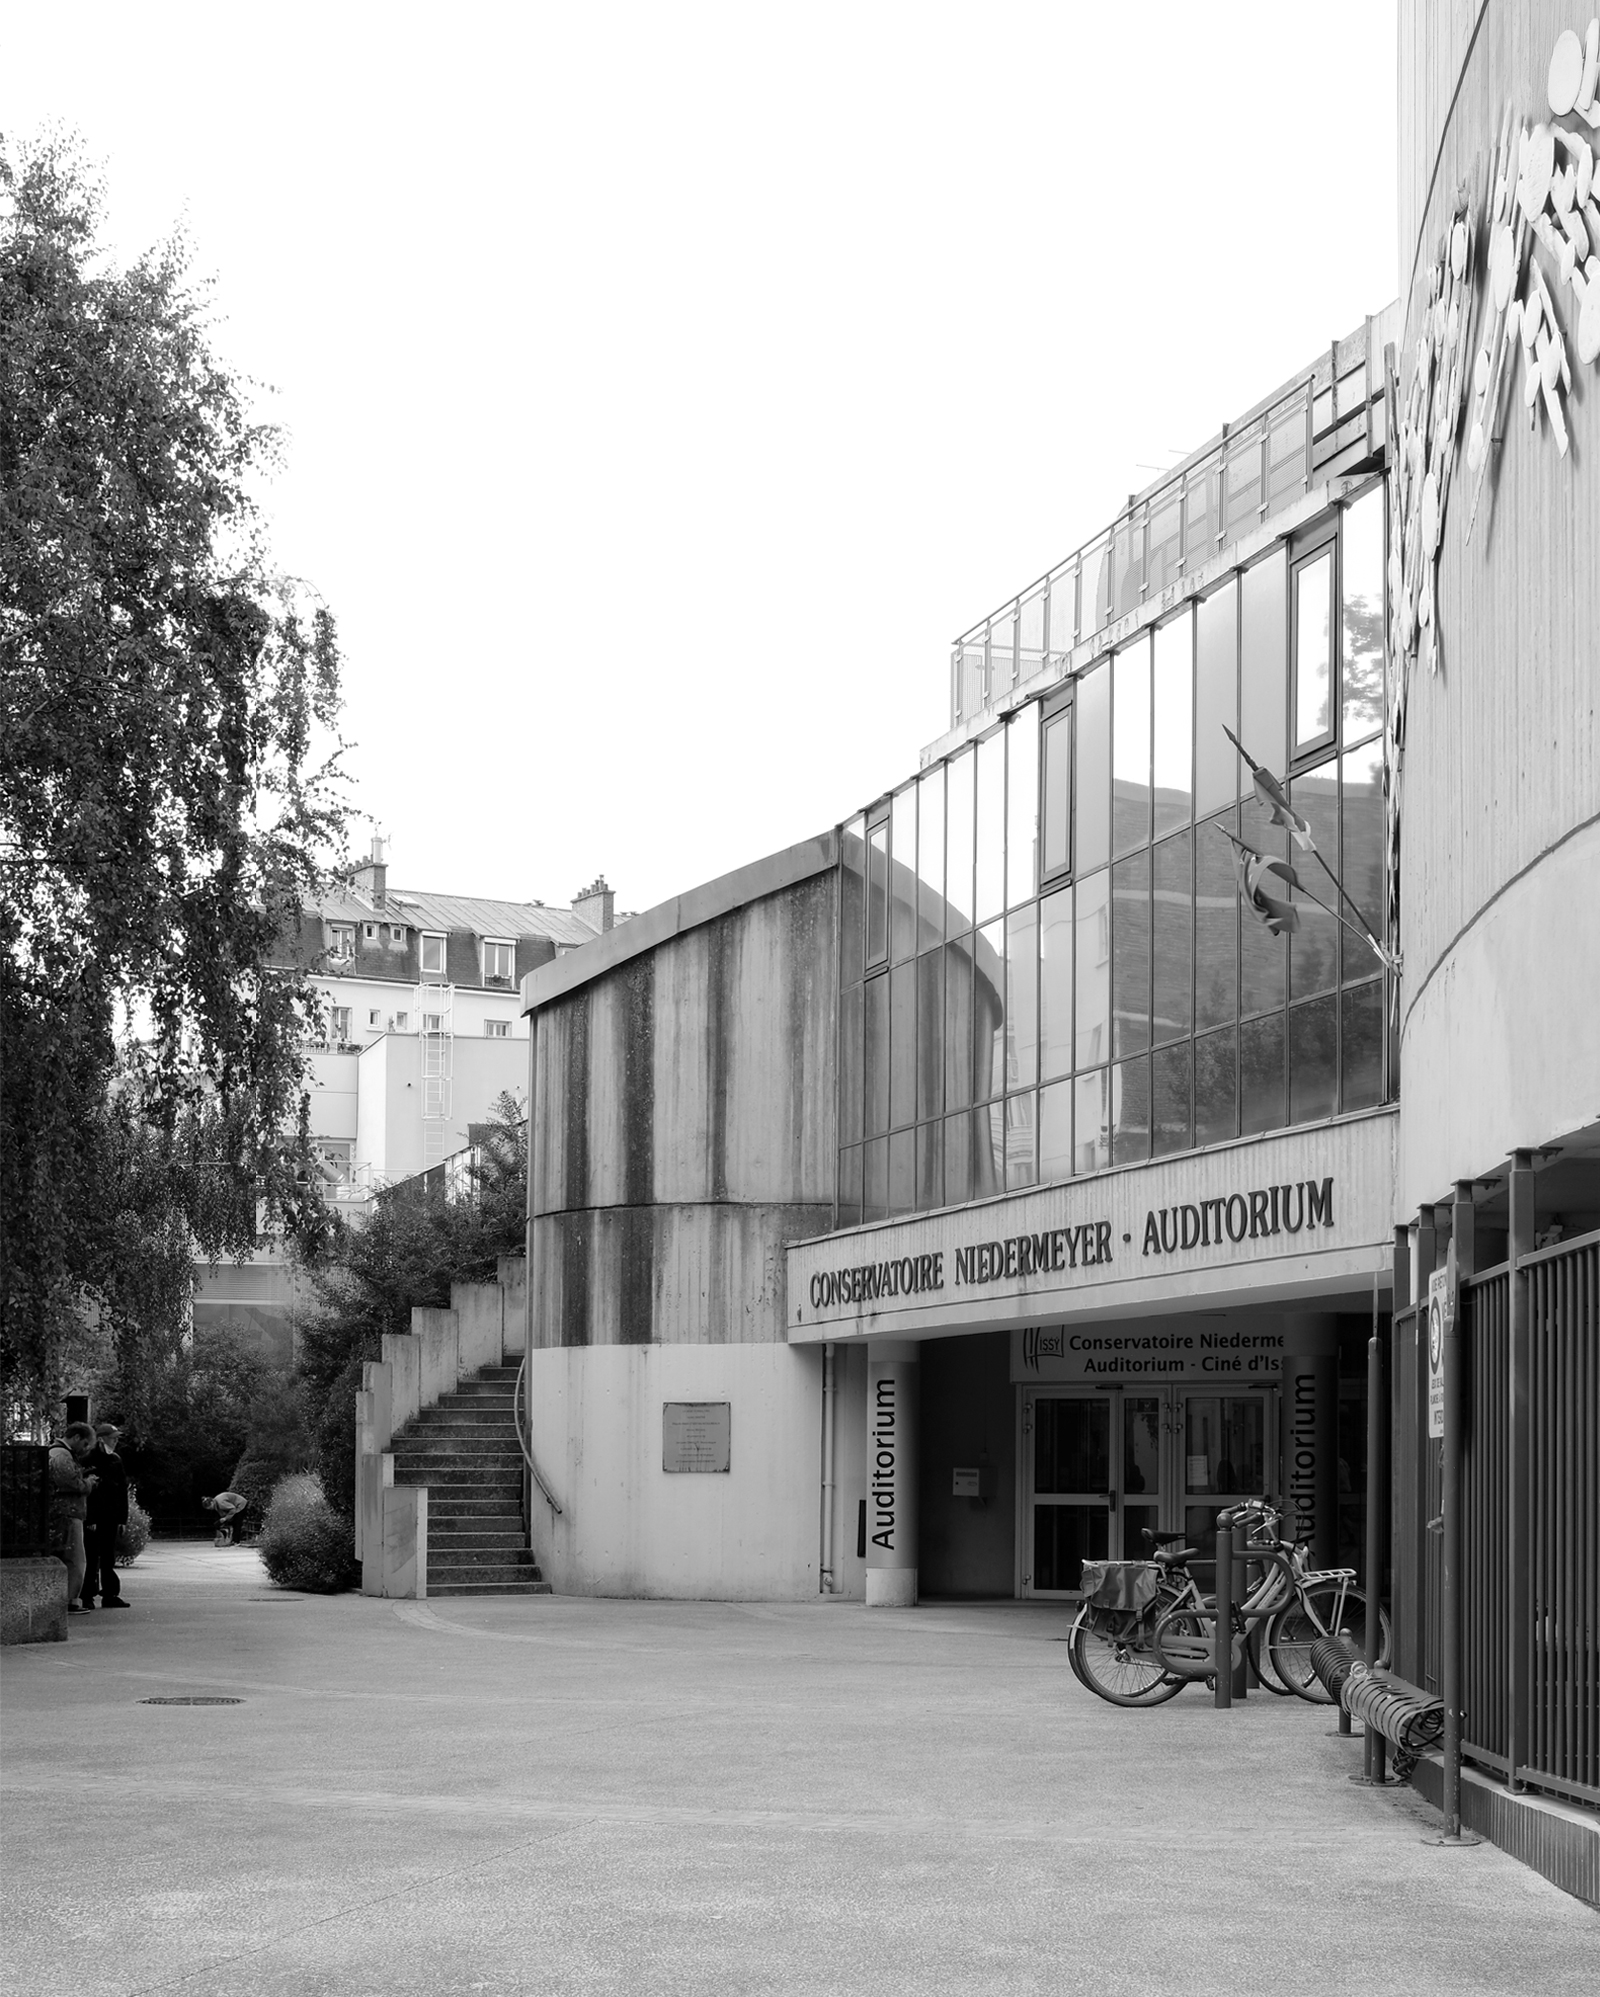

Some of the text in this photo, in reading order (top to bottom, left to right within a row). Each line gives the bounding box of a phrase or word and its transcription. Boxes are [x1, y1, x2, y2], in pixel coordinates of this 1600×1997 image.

[809, 1251, 944, 1309] CONSERVATOIRE
[954, 1220, 1113, 1286] NIEDERMEYER
[1142, 1177, 1335, 1257] AUDITORIUM
[1069, 1334, 1194, 1351] Conservatoire
[1083, 1356, 1185, 1373] Auditorium
[1201, 1355, 1242, 1372] Ciné
[871, 1379, 895, 1550] Auditorium
